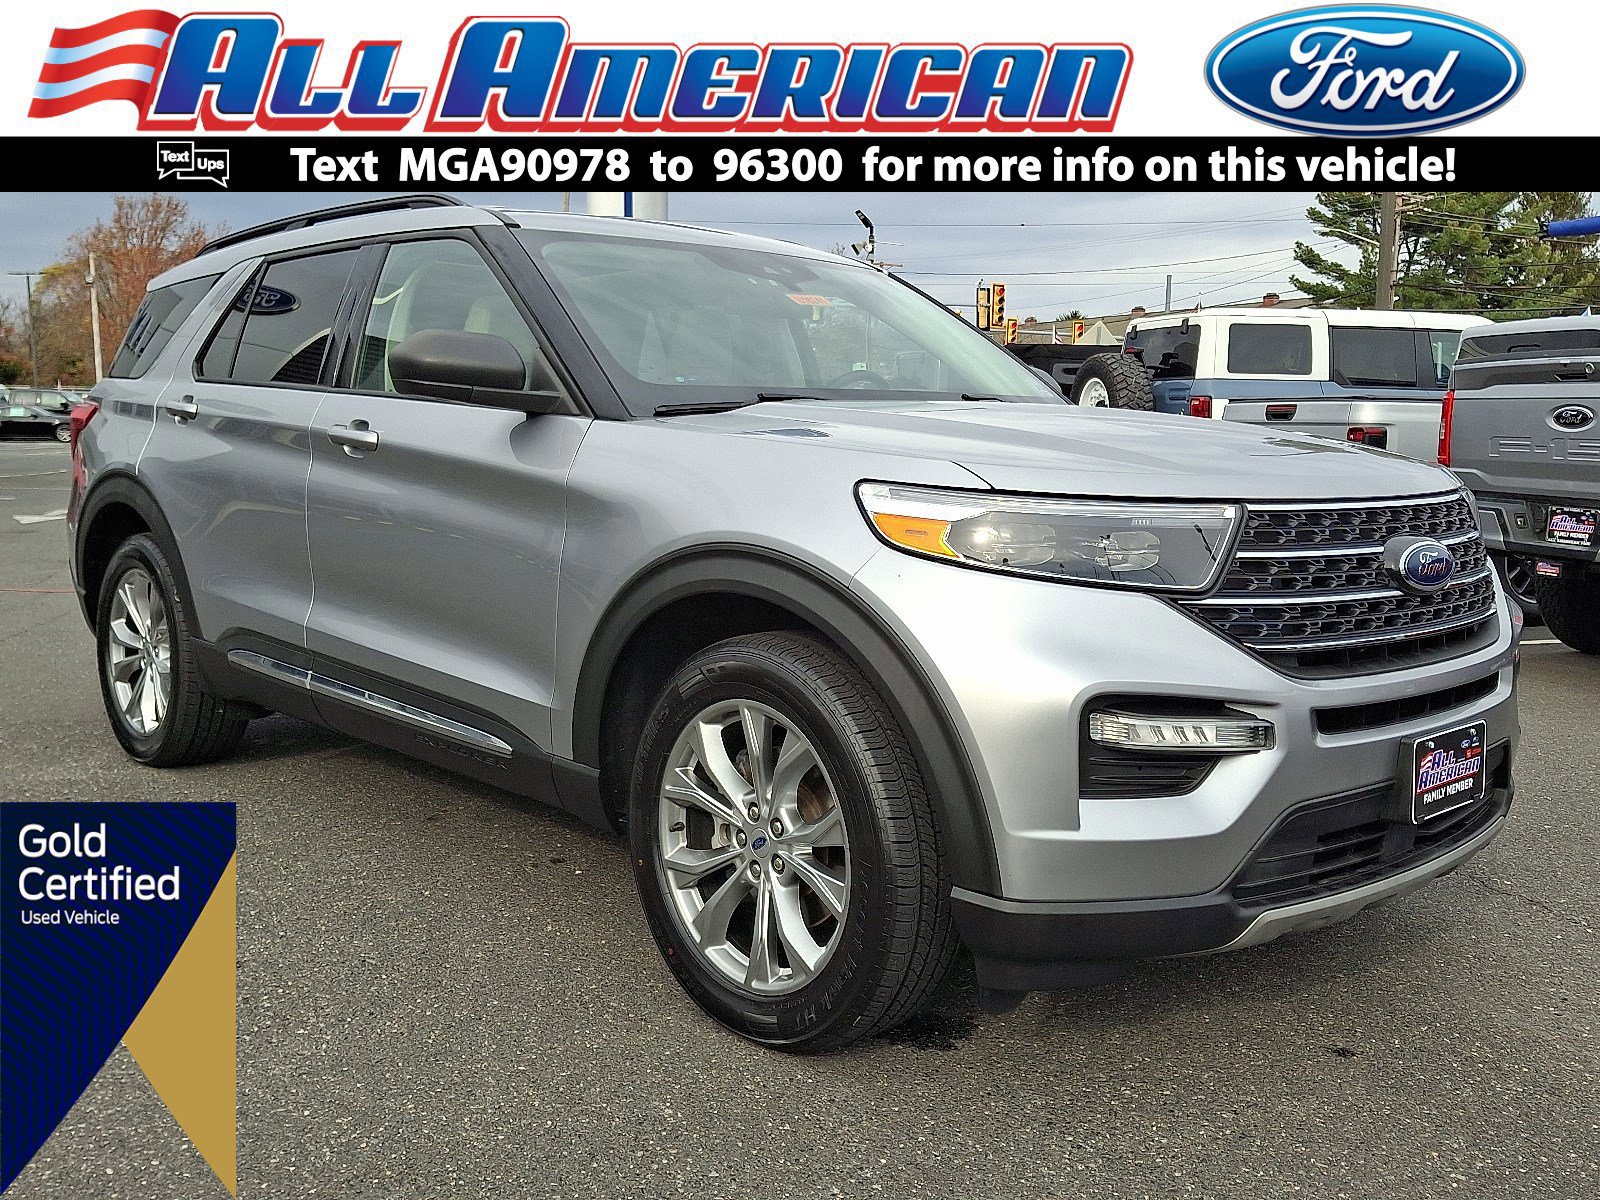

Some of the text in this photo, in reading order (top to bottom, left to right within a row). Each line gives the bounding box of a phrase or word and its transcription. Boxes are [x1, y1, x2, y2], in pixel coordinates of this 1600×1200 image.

[1559, 410, 1583, 424] Ford
[1418, 551, 1449, 576] Ford
[1423, 777, 1474, 805] FAMILY MEMBER
